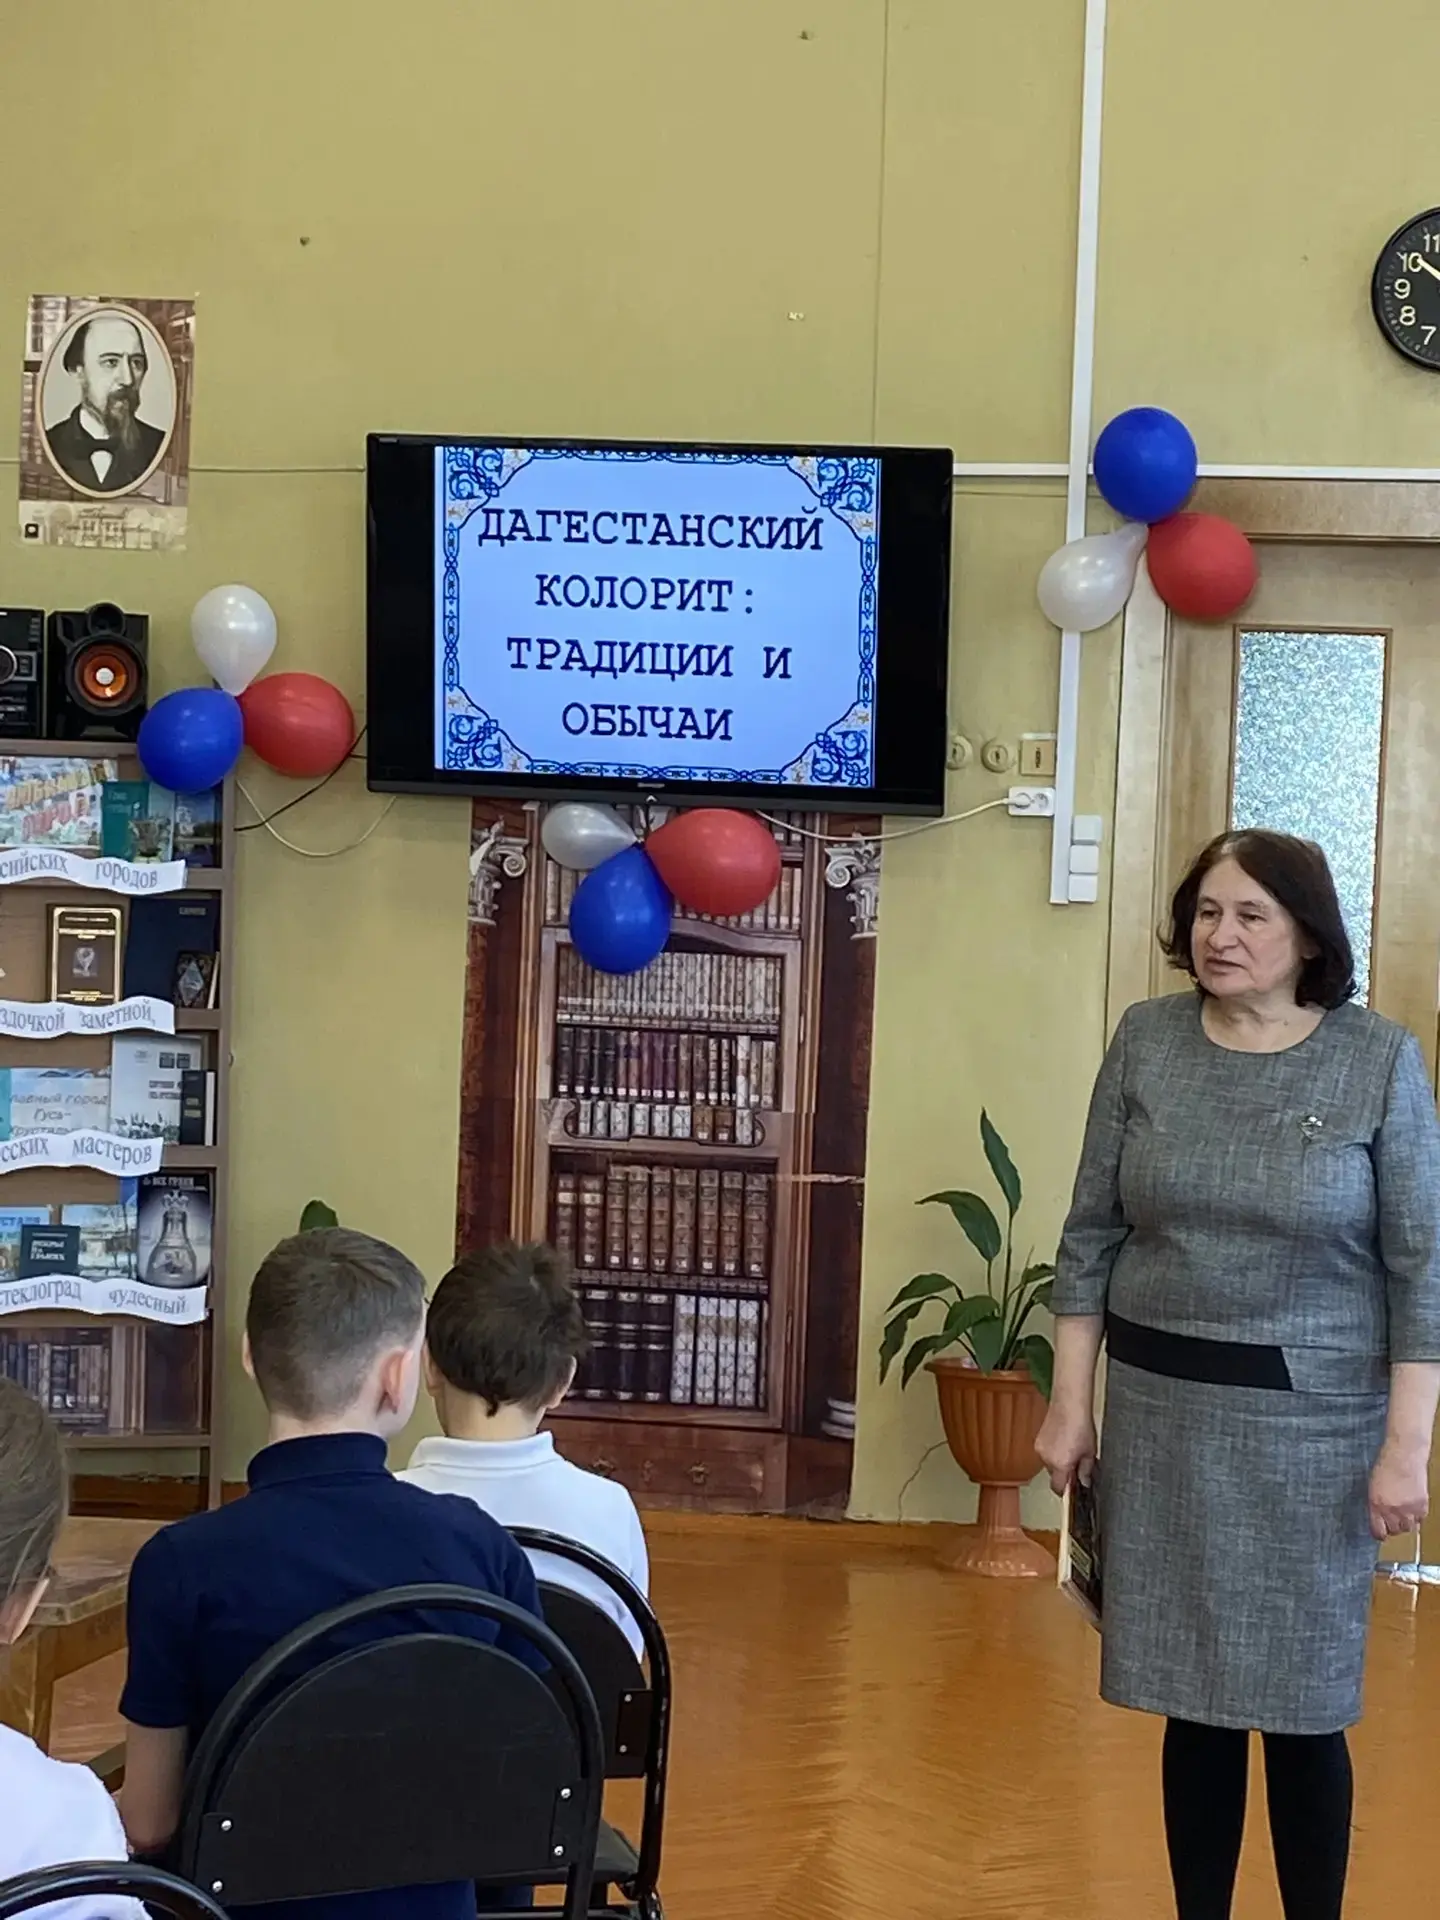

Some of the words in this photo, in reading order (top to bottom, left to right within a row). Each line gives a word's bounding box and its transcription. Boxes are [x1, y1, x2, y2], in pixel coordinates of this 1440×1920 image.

[1423, 233, 1440, 253] 11
[1396, 252, 1422, 273] 10
[1394, 278, 1411, 299] 9
[1400, 305, 1416, 326] 8
[1420, 325, 1437, 345] 7
[477, 505, 824, 550] ДАГЕСТАНСКИЙ
[534, 574, 754, 614] КОЛОРИТ:
[506, 636, 734, 681] ТРАДИЦИИ
[762, 646, 792, 680] И
[561, 701, 733, 741] ОБЫЧАИ
[95, 860, 158, 889] городов
[79, 998, 157, 1028] заметной,
[72, 1136, 152, 1170] мастеров
